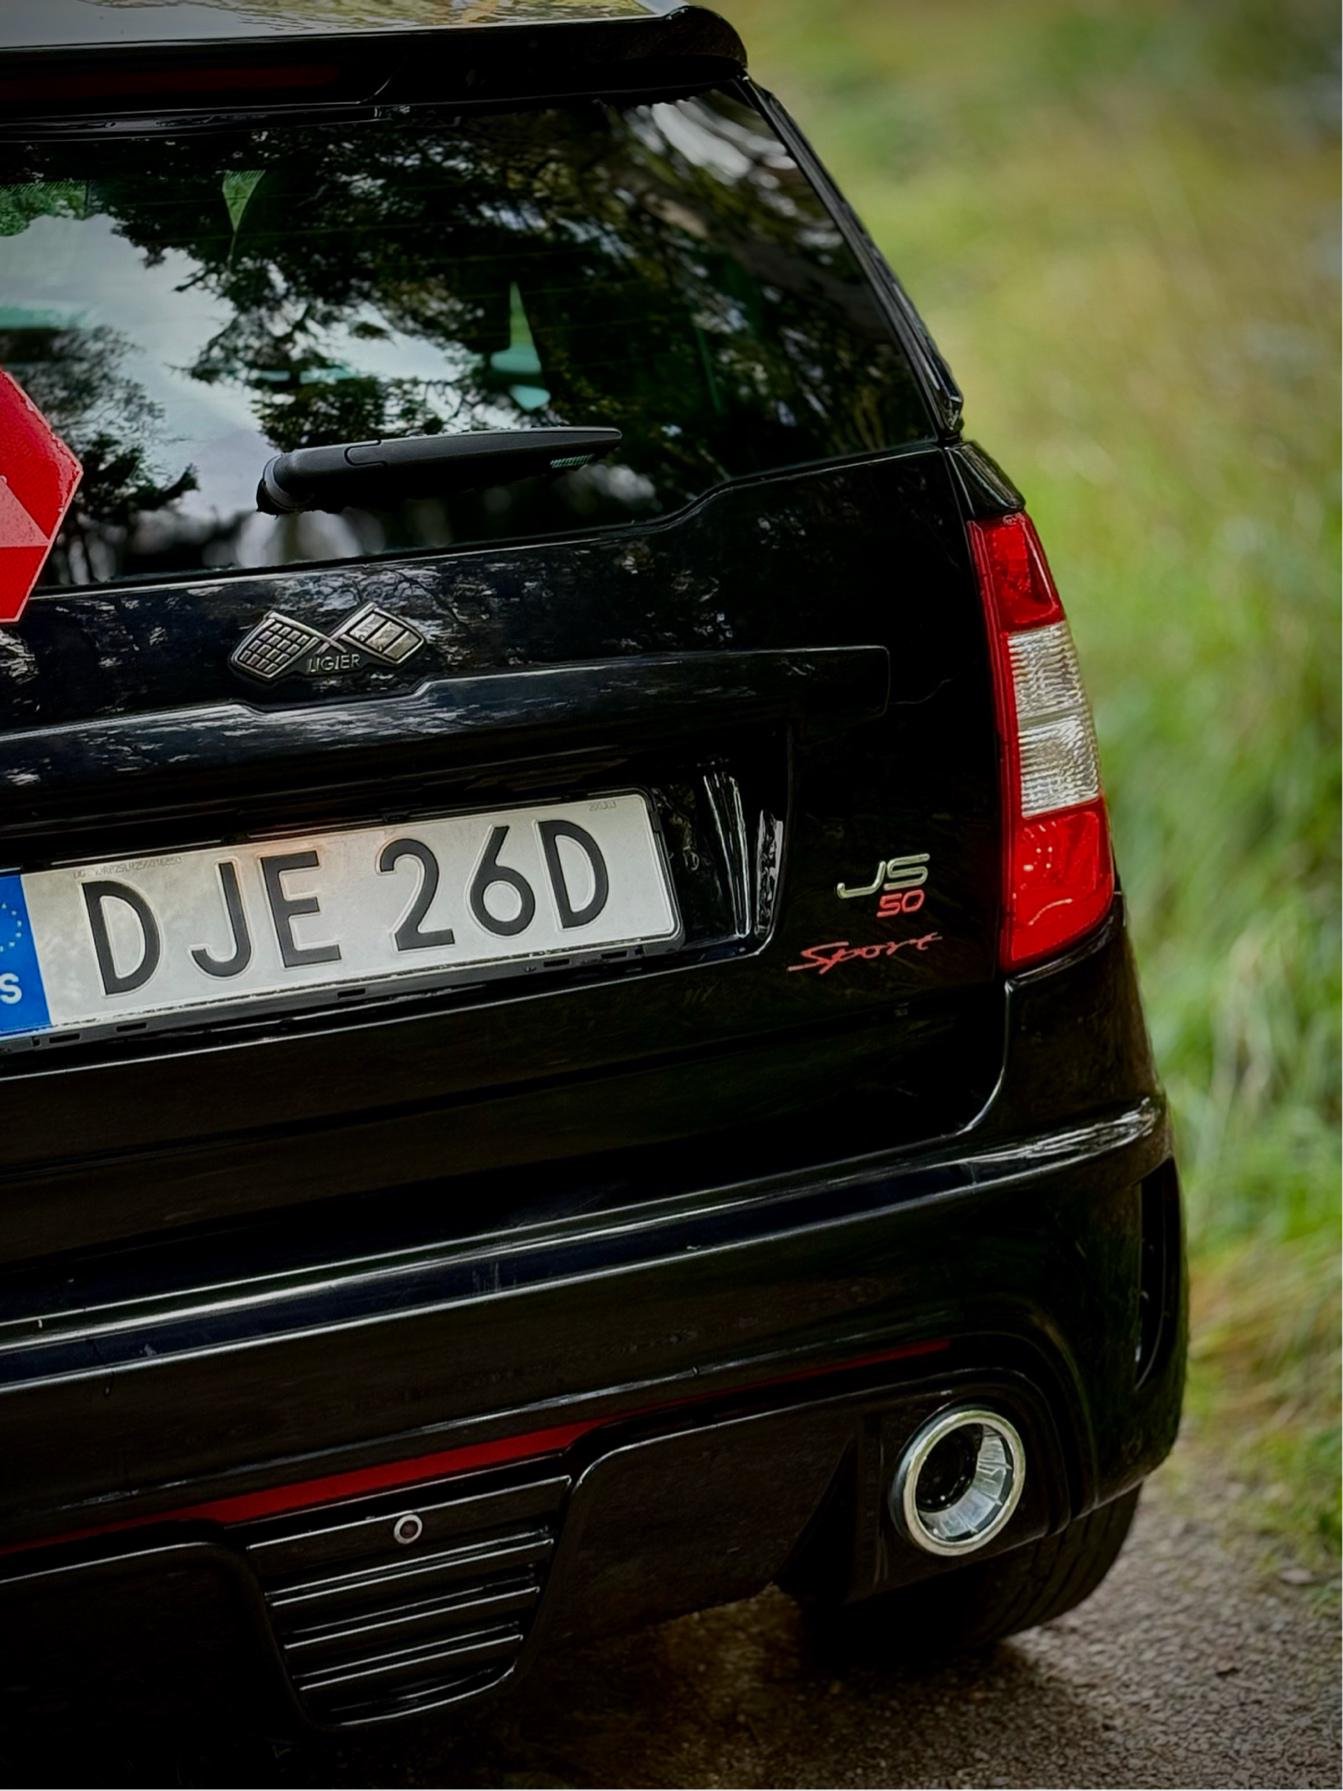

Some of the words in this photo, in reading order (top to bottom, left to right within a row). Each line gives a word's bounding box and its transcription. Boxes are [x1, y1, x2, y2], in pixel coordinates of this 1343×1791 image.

[308, 653, 361, 673] LIGIER
[836, 853, 930, 899] JS
[81, 850, 342, 995] DJE
[380, 819, 609, 951] 26D
[876, 889, 925, 918] 50
[786, 931, 943, 975] Sport
[0, 972, 23, 1005] S
